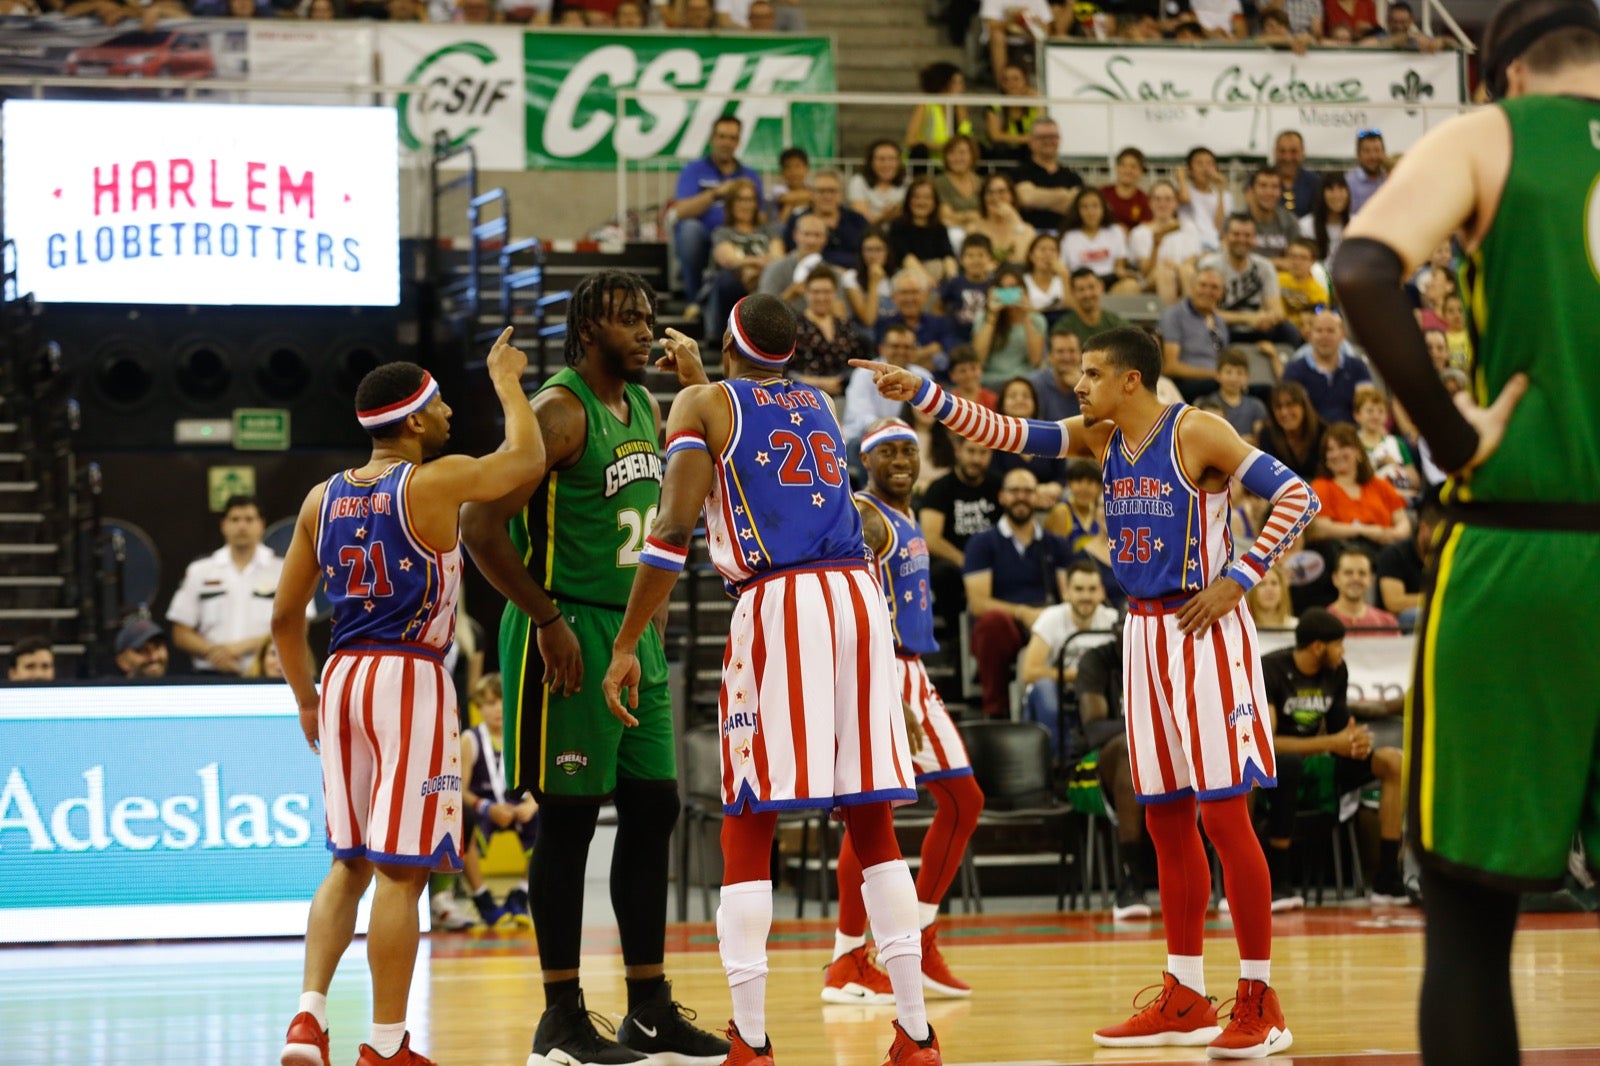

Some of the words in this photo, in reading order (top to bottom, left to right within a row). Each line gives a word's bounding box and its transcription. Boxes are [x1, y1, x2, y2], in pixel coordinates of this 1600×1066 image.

[416, 76, 515, 117] CSIF
[542, 45, 814, 159] CSIF
[94, 158, 315, 219] HARLEM
[47, 222, 361, 273] GLOBETROTTERS
[768, 429, 843, 488] 26
[338, 541, 394, 598] 21
[1117, 527, 1152, 563] 25
[0, 761, 311, 853] Adeslas
